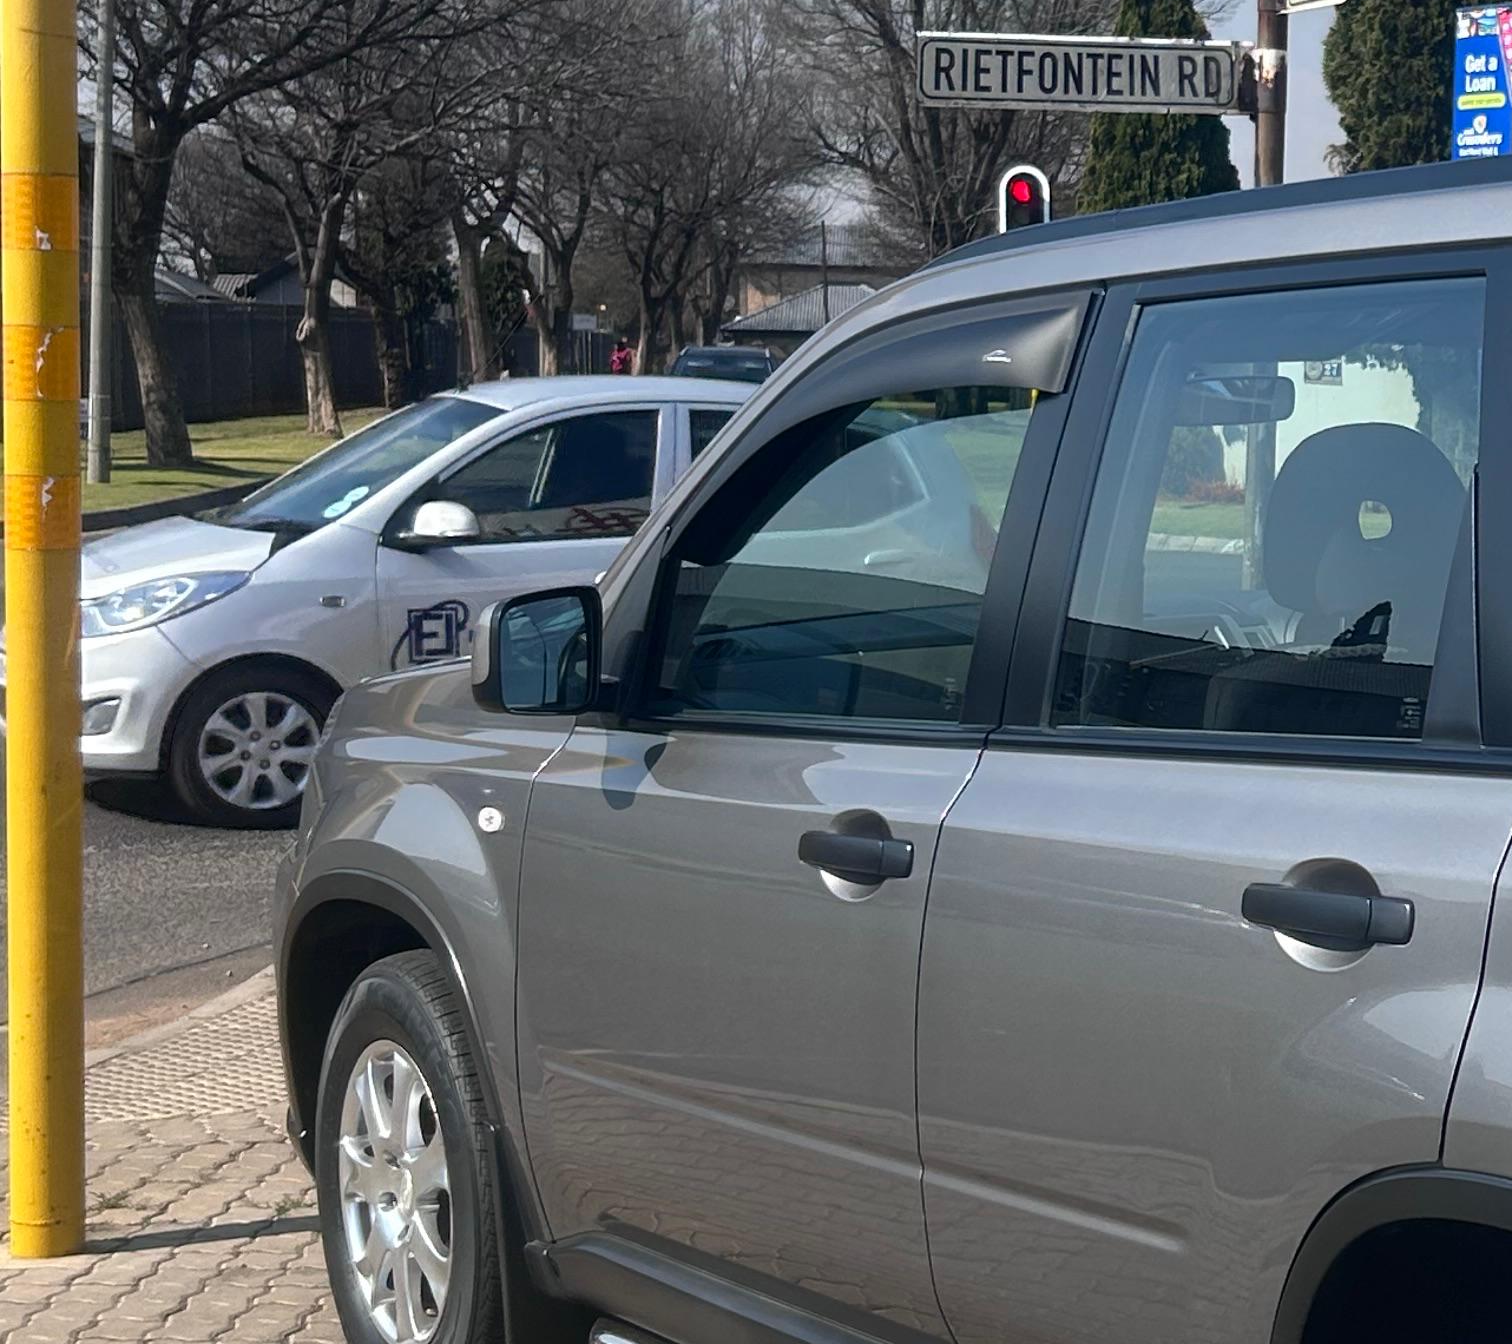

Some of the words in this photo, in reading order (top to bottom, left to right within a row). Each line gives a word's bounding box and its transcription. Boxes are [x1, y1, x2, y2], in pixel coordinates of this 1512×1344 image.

[933, 46, 1161, 97] RIETFONTEIN
[1178, 54, 1222, 99] RD
[1465, 55, 1487, 73] Get
[1488, 57, 1498, 71] a
[1465, 75, 1496, 93] Loan
